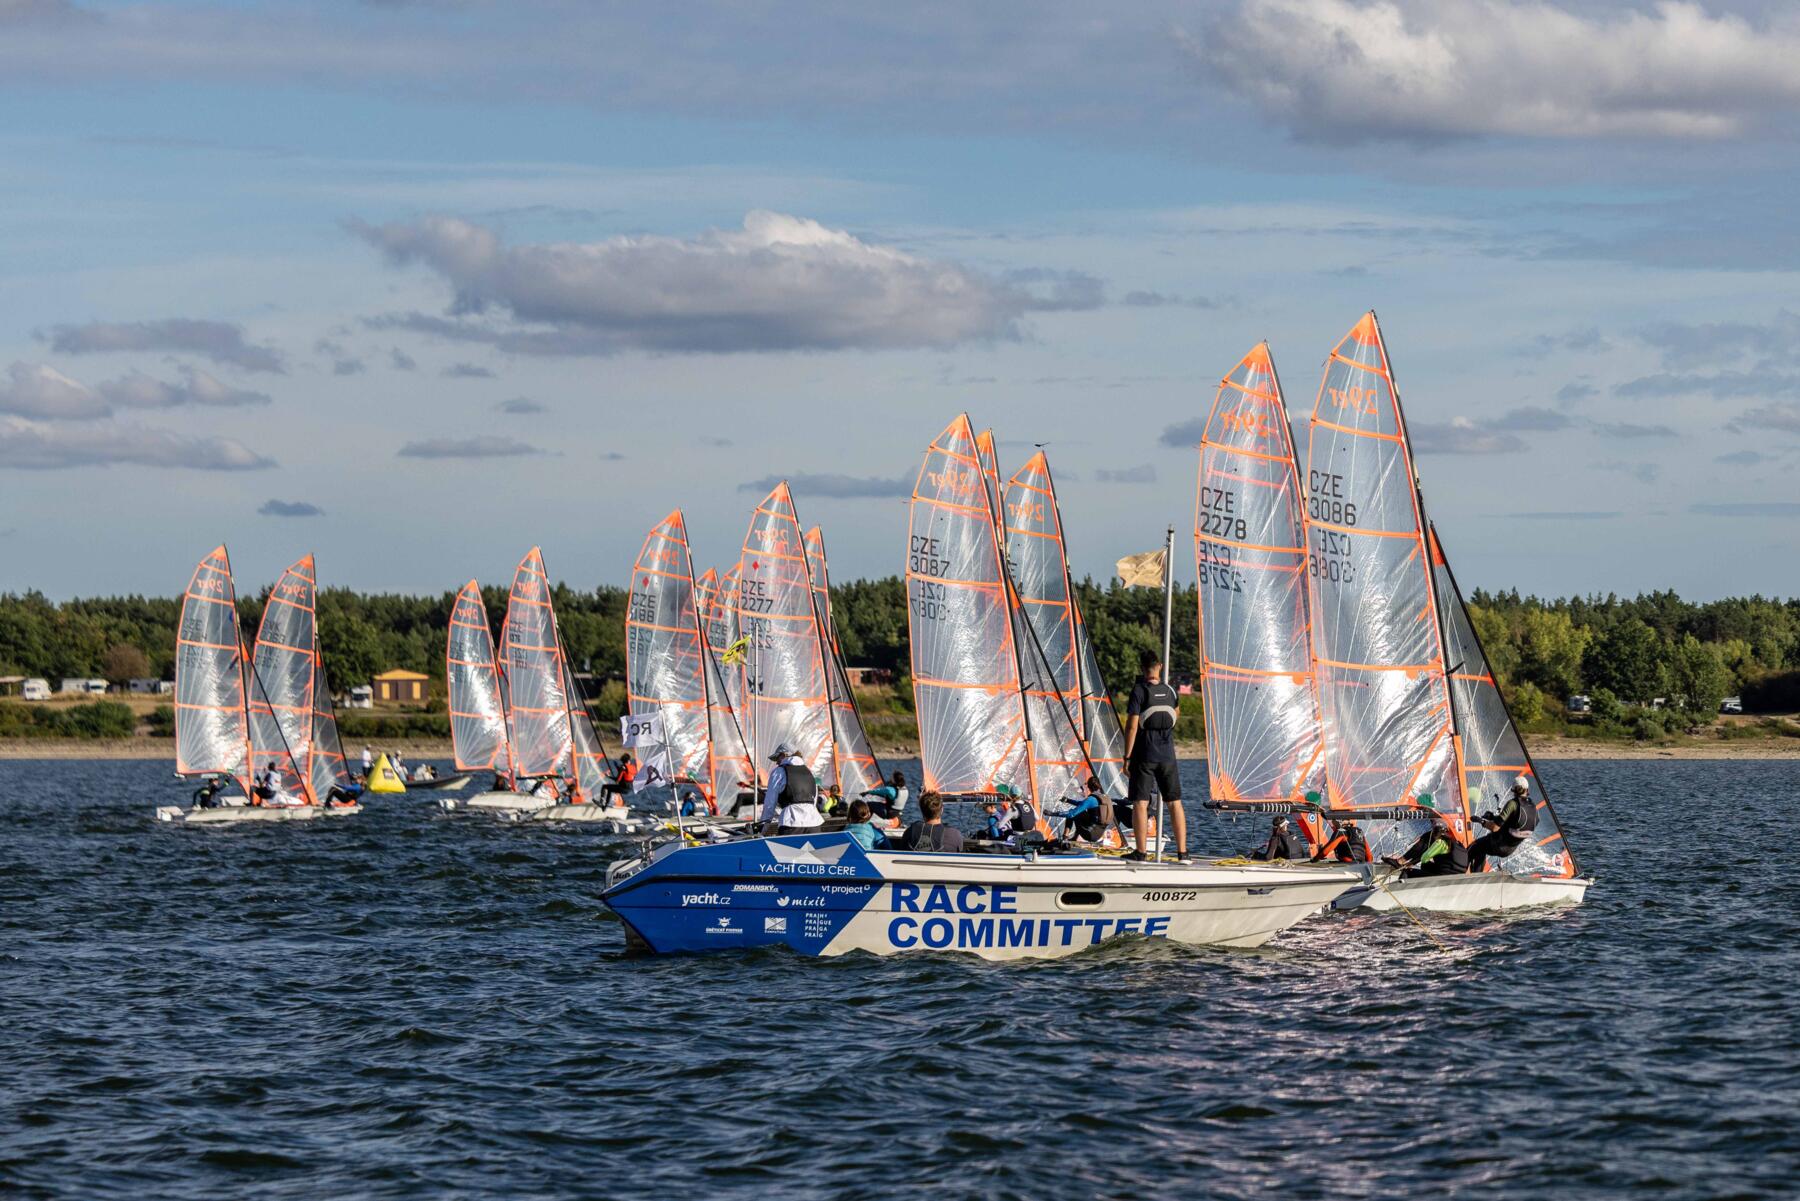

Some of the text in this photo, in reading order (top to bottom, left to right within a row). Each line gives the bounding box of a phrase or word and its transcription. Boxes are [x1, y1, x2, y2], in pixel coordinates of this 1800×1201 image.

[1310, 469, 1344, 499] CZE
[1201, 486, 1234, 514] CZE
[1310, 497, 1357, 526] 3086
[1200, 511, 1247, 541] 2278
[911, 535, 940, 557] CZE
[910, 555, 950, 578] 3087
[741, 580, 765, 596] CZE
[631, 592, 657, 609] CZE
[740, 596, 774, 613] 2277
[759, 862, 857, 876] YACHT CLUB CERE
[681, 892, 731, 907] yacht.cz
[831, 886, 863, 895] project
[890, 883, 1018, 914] RACE
[1142, 891, 1197, 902] 400872
[791, 896, 826, 907] mixit
[888, 916, 1172, 949] COMMITTEE
